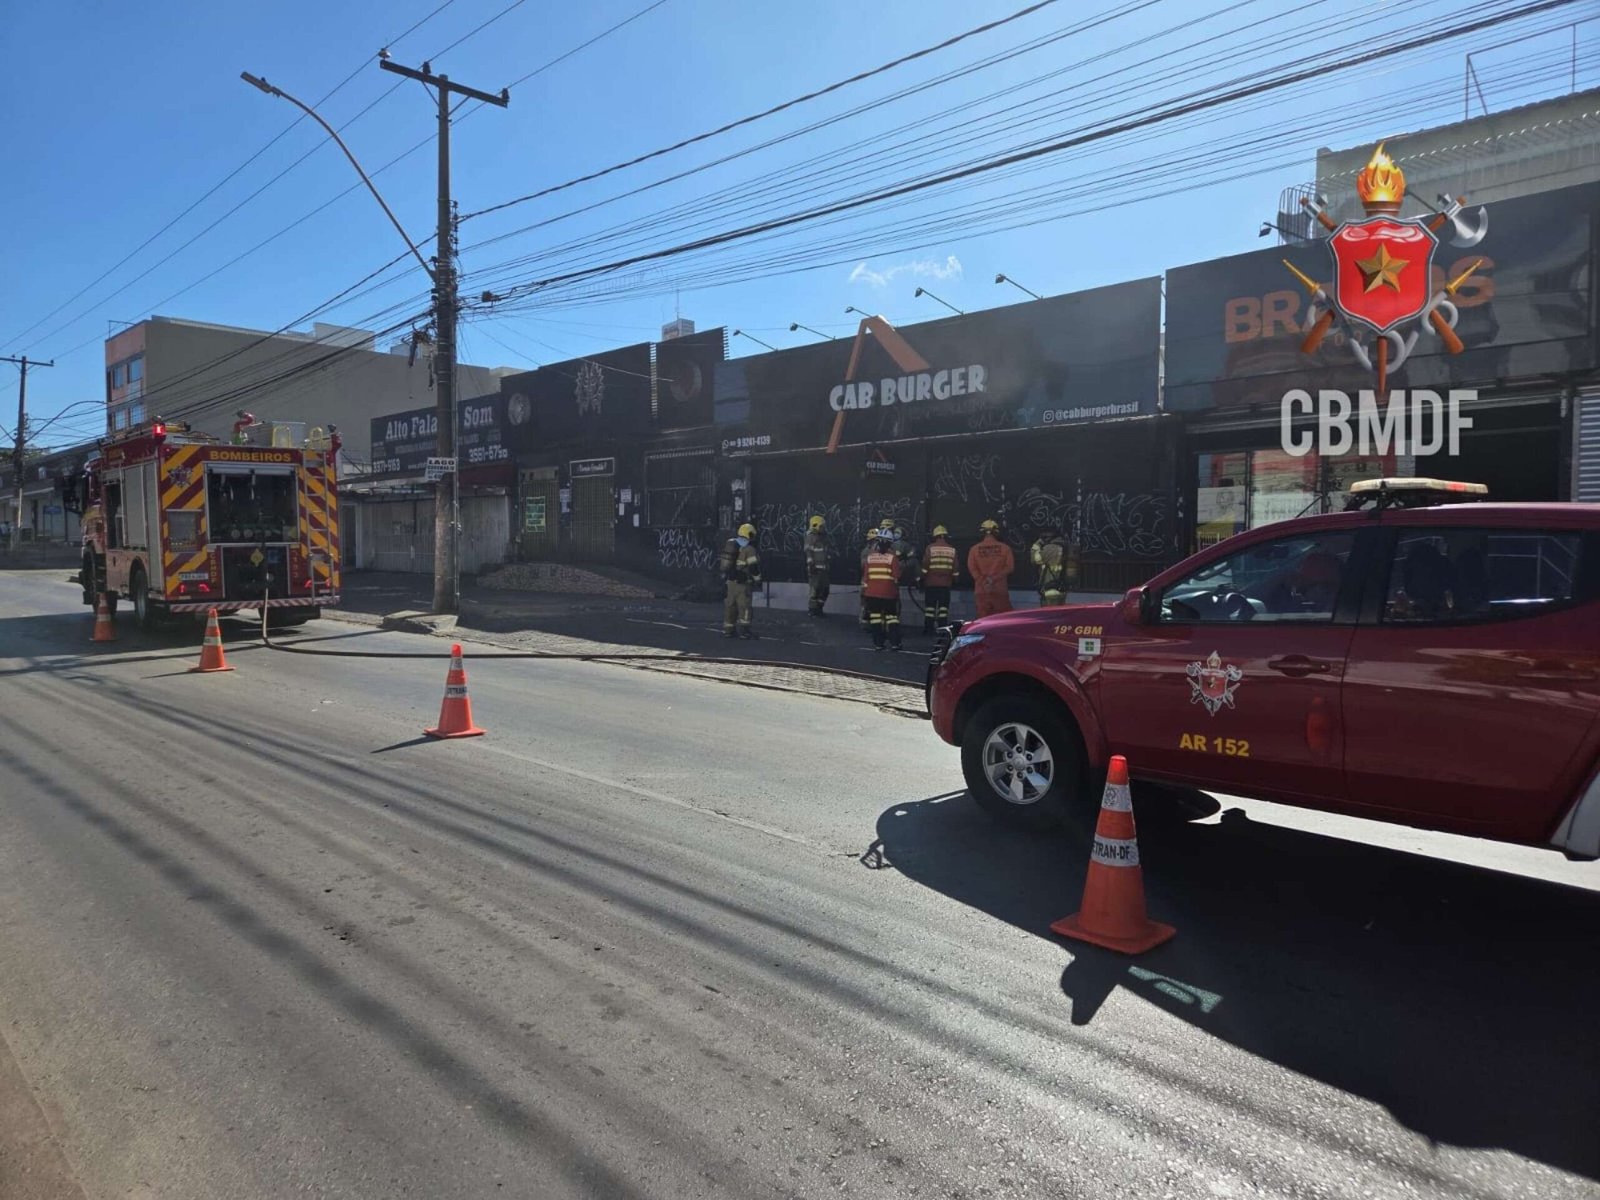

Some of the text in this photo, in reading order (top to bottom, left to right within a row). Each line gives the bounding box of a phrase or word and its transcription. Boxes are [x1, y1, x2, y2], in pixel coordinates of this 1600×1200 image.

[829, 364, 986, 412] CAB BURGER
[1055, 401, 1139, 421] @cabburgerbrasil
[385, 405, 494, 440] Alto Fala Som
[209, 450, 292, 463] BOMBEIROS
[1074, 625, 1103, 636] GBM
[1179, 733, 1250, 757] AR 152
